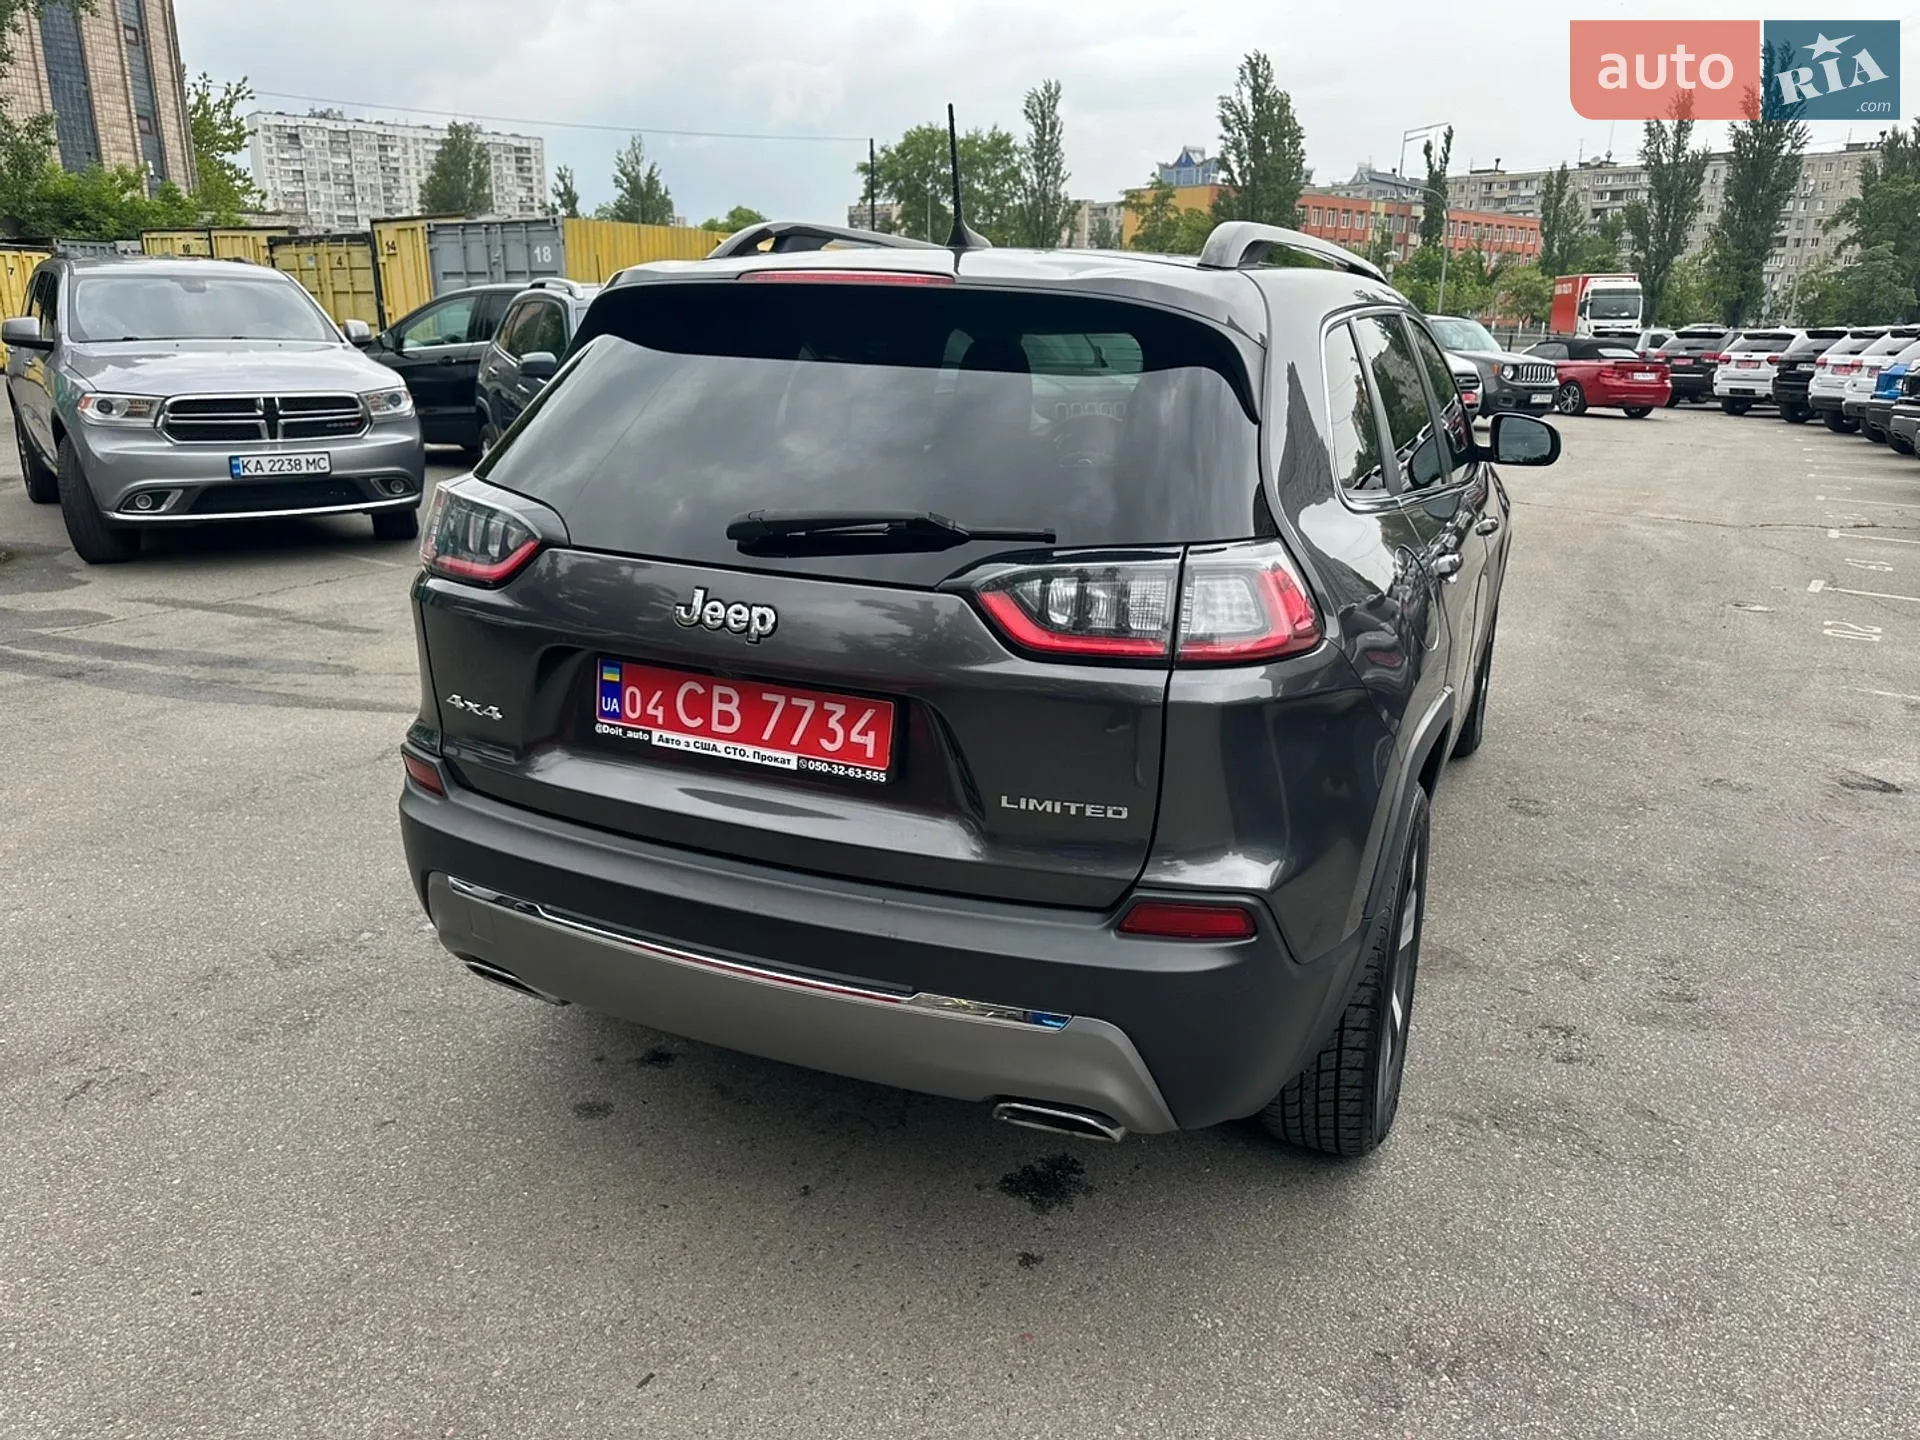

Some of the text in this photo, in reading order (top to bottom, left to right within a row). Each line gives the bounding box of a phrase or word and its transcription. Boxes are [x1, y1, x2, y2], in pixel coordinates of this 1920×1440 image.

[385, 241, 397, 252] 14
[534, 246, 551, 262] 18
[336, 256, 343, 267] 4
[8, 267, 14, 275] 7
[241, 459, 264, 473] KA
[268, 458, 302, 472] 2238
[306, 457, 327, 471] MC
[674, 586, 777, 645] Jeep
[446, 694, 503, 721] 4x4
[602, 696, 620, 713] UA
[625, 681, 876, 759] 04 CB 7734
[595, 723, 649, 741] @Doit_auto
[657, 734, 681, 747] Авто
[753, 751, 791, 767] Прокат
[808, 762, 887, 782] 050-32-63-555
[1001, 795, 1129, 820] LIMITED
